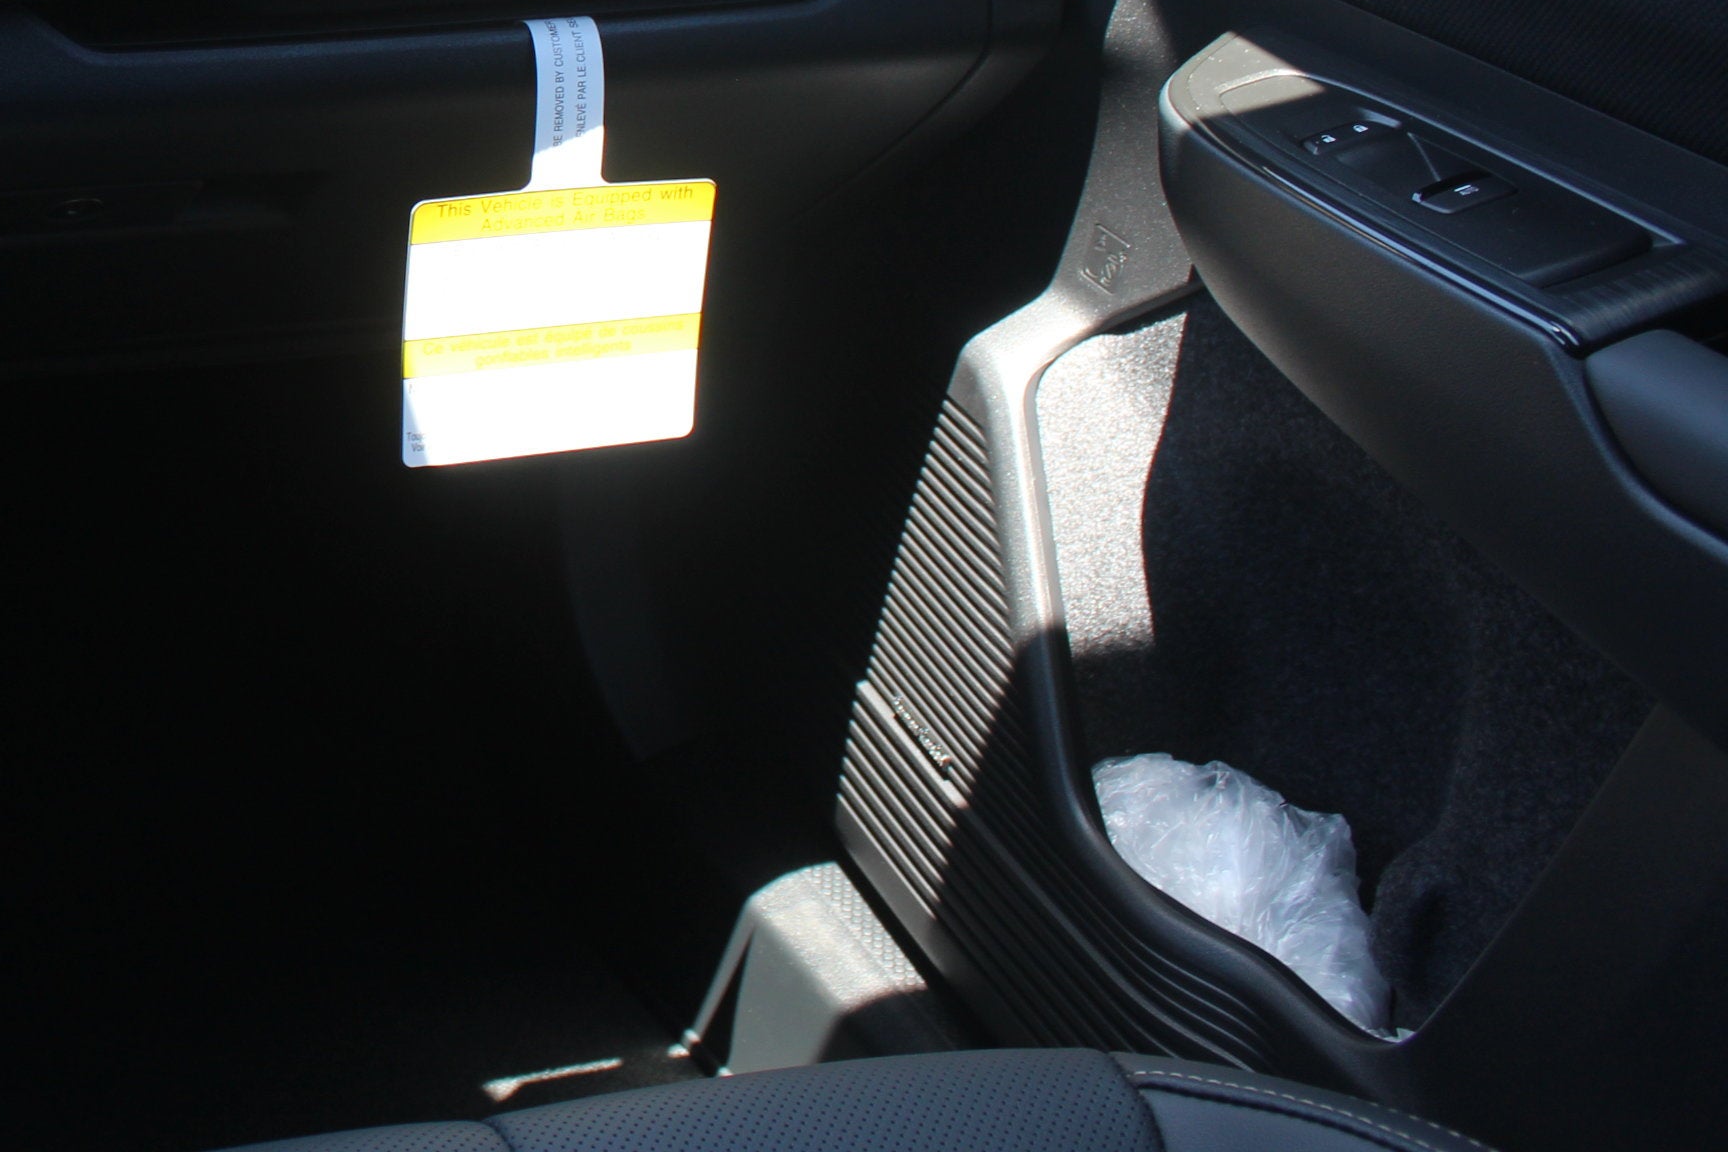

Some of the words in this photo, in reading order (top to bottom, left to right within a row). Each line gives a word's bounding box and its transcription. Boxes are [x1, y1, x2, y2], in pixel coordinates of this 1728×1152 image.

[572, 31, 586, 63] CLIENT
[555, 71, 564, 83] BY
[576, 65, 586, 78] LE
[577, 80, 587, 100] PAR
[553, 87, 565, 132] REMOVED
[437, 204, 471, 219] This
[480, 197, 543, 214] Vehicle
[660, 186, 693, 201] with
